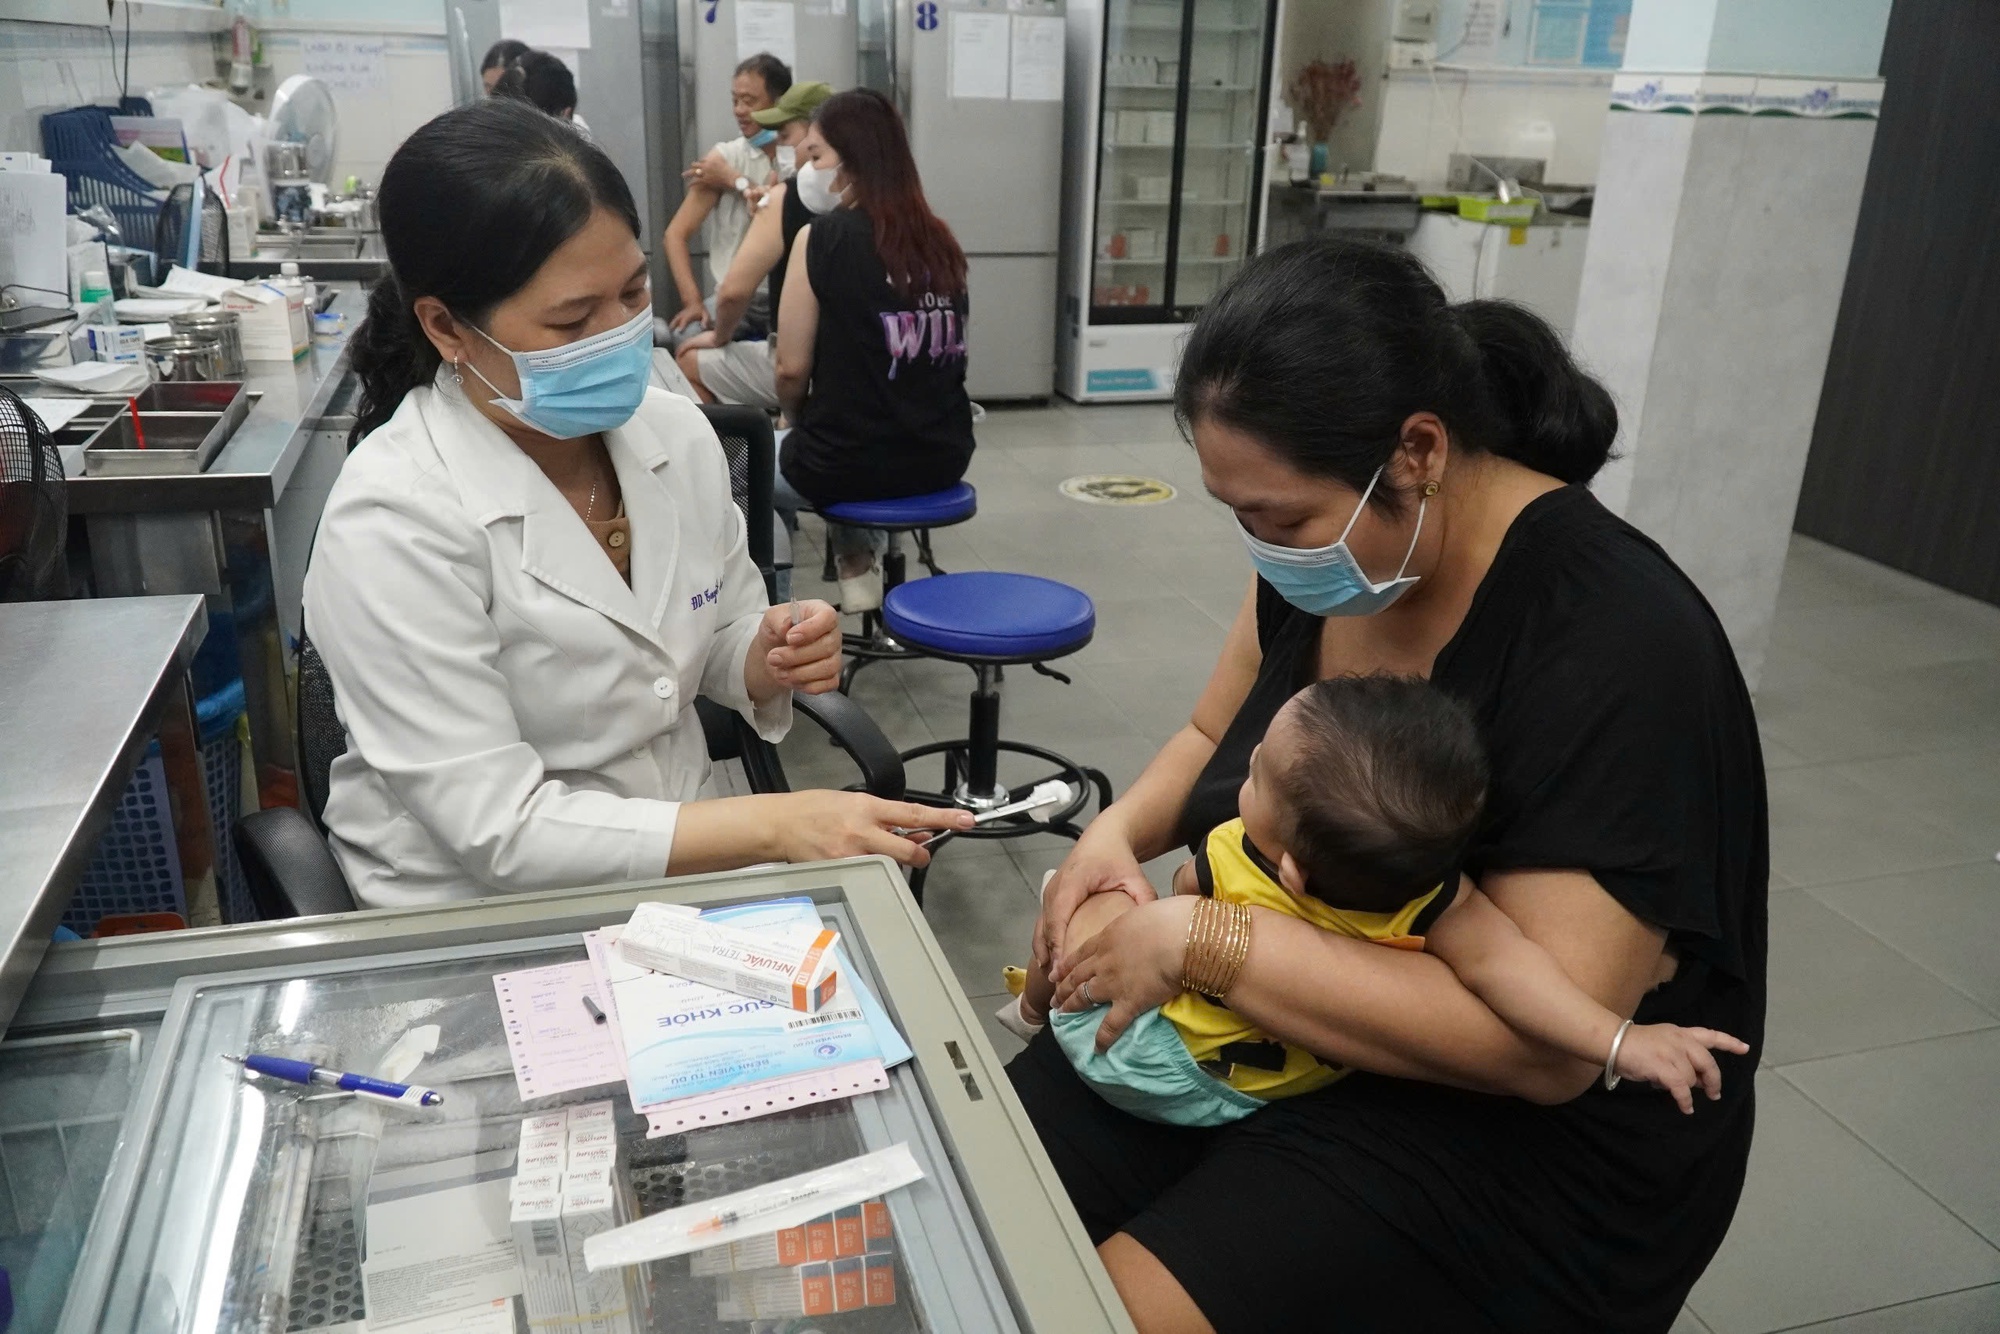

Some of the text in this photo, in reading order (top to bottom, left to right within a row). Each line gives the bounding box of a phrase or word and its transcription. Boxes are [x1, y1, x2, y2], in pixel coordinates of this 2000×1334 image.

[704, 0, 719, 23] 7
[917, 1, 938, 30] 8
[879, 308, 967, 364] WIL
[711, 945, 741, 959] TETRA
[742, 953, 796, 977] INFLUVAC
